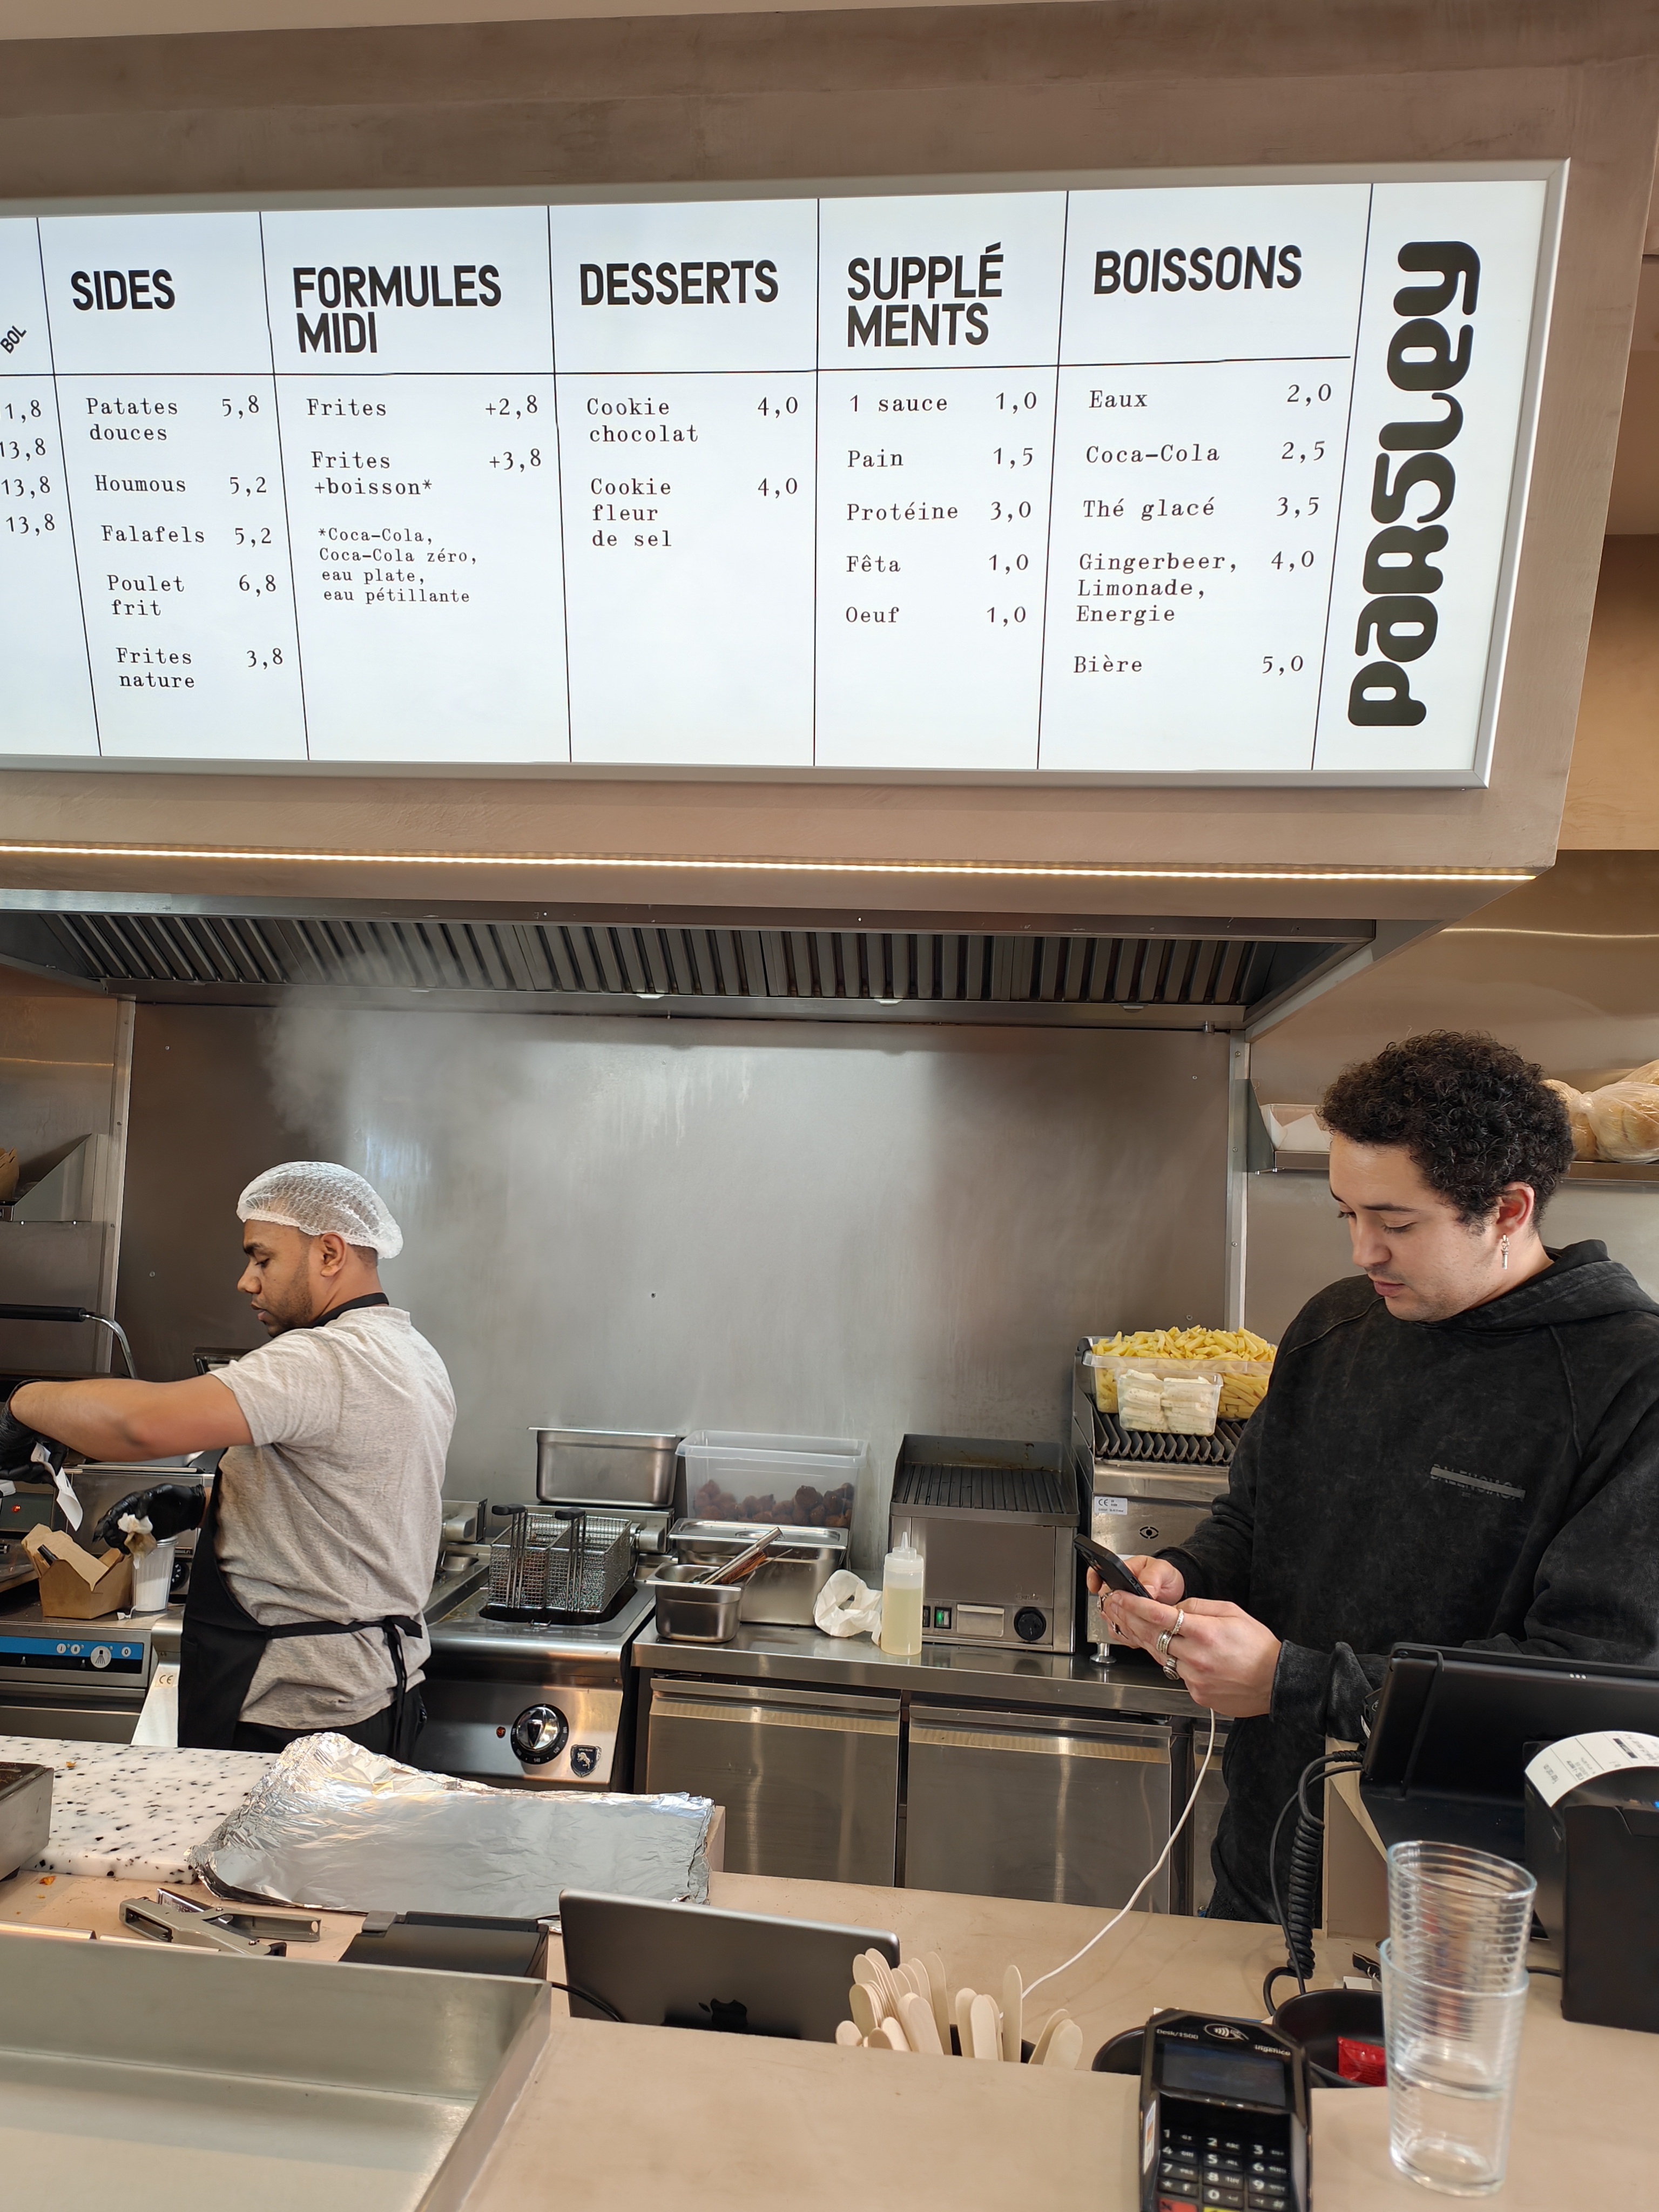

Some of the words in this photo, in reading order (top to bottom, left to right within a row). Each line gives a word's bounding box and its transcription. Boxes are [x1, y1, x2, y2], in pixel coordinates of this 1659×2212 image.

[848, 241, 1003, 301] SUPPLÉ
[1094, 245, 1301, 294] BOISSONS
[71, 269, 175, 311] SIDES
[293, 265, 501, 308] FORMULES
[580, 260, 778, 305] DESSERTS
[296, 312, 377, 353] MIDI
[848, 302, 988, 347] MENTS
[0, 326, 26, 354] BOL
[850, 395, 858, 412] 1
[879, 399, 947, 412] sauce
[996, 392, 1036, 414] 1,0
[1089, 390, 1147, 408] Eaux
[1287, 384, 1331, 406] 2,0
[86, 398, 177, 414] Patates
[222, 395, 259, 419] 5,8
[307, 399, 386, 416] Frites
[485, 395, 537, 419] +2,8
[587, 397, 669, 415] Cookie
[758, 397, 798, 418] 4,0
[90, 424, 166, 440] douces
[590, 424, 698, 442] chocolat
[311, 451, 389, 468] Frites
[489, 448, 541, 472] +3,8
[848, 449, 903, 467] Pain
[994, 448, 1033, 469] 1,5
[1087, 444, 1219, 463] Coca-Cola
[1282, 441, 1325, 463] 2,5
[1, 476, 50, 498] 13,8
[95, 475, 185, 492] Houmous
[230, 477, 266, 496] 5,2
[591, 478, 670, 495] Cookie
[758, 478, 797, 498] 4,0
[592, 504, 658, 521] fleur
[847, 502, 957, 520] Protéine
[990, 501, 1031, 522] 3,0
[1083, 498, 1124, 517] Thé
[1141, 497, 1215, 521] glacé
[1277, 497, 1319, 518] 3,5
[6, 514, 55, 536] 13,8
[101, 525, 204, 543] Falafels
[235, 528, 271, 547] 5,2
[592, 530, 617, 546] de
[635, 530, 671, 547] sel
[320, 548, 414, 562] Coca-Cola
[427, 548, 475, 564] zéro,
[846, 555, 900, 572] Fêta
[989, 554, 1028, 575] 1,0
[1080, 552, 1236, 574] Gingerbeer,
[1271, 551, 1314, 572] 4,0
[107, 575, 184, 592] Poulet
[239, 575, 276, 597] 6,8
[322, 571, 352, 581] eau
[363, 568, 423, 585] plate,
[324, 591, 354, 601] eau
[365, 588, 469, 604] pétillante
[1078, 579, 1204, 599] Limonade,
[111, 599, 160, 616] frit
[846, 606, 899, 623] Oeuf
[987, 606, 1026, 626] 1,0
[1076, 605, 1175, 626] Energie
[116, 648, 191, 664] Frites
[247, 648, 282, 670] 3,8
[1074, 655, 1142, 673] Bière
[1263, 656, 1303, 676] 5,0
[119, 672, 194, 687] nature
[1162, 2146, 1172, 2155] 4
[1207, 2137, 1217, 2147] 2
[1253, 2144, 1264, 2155] 3
[1162, 2163, 1172, 2173] 7
[1208, 2154, 1218, 2164] 5
[1253, 2162, 1264, 2172] 6
[1207, 2172, 1219, 2182] 8
[1252, 2180, 1264, 2190] 9
